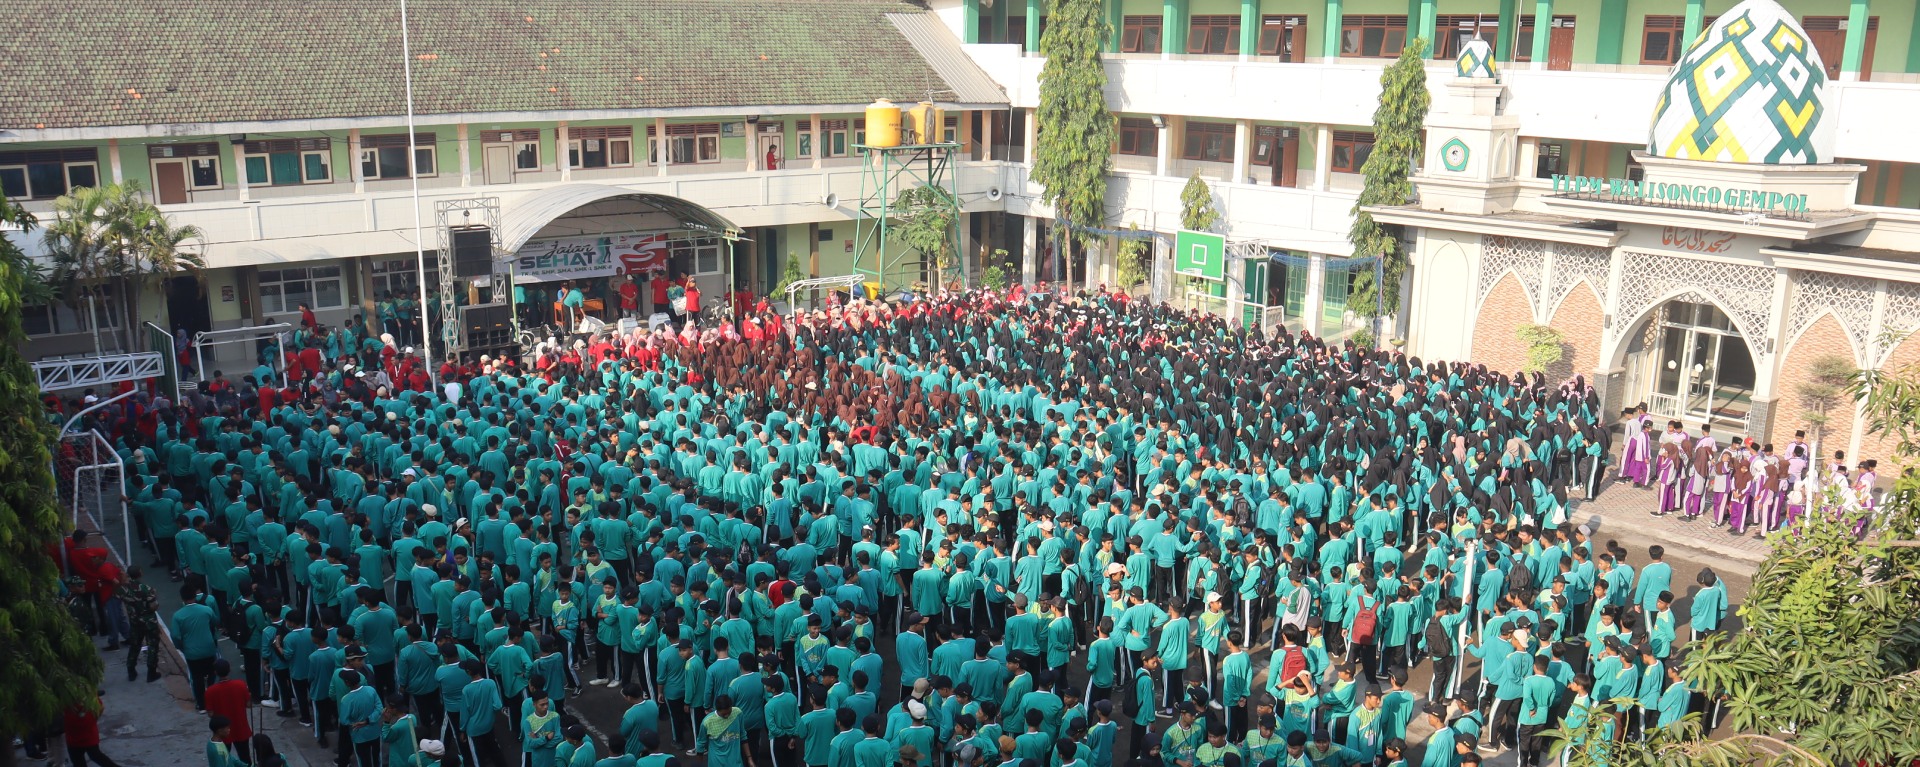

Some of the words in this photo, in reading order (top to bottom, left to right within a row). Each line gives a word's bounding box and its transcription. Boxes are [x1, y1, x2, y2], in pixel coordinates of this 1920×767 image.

[1551, 173, 1604, 195] YLPM
[1609, 177, 1722, 204] WALISONGO
[1724, 188, 1811, 214] GEMPOL
[520, 252, 596, 270] SEHAT
